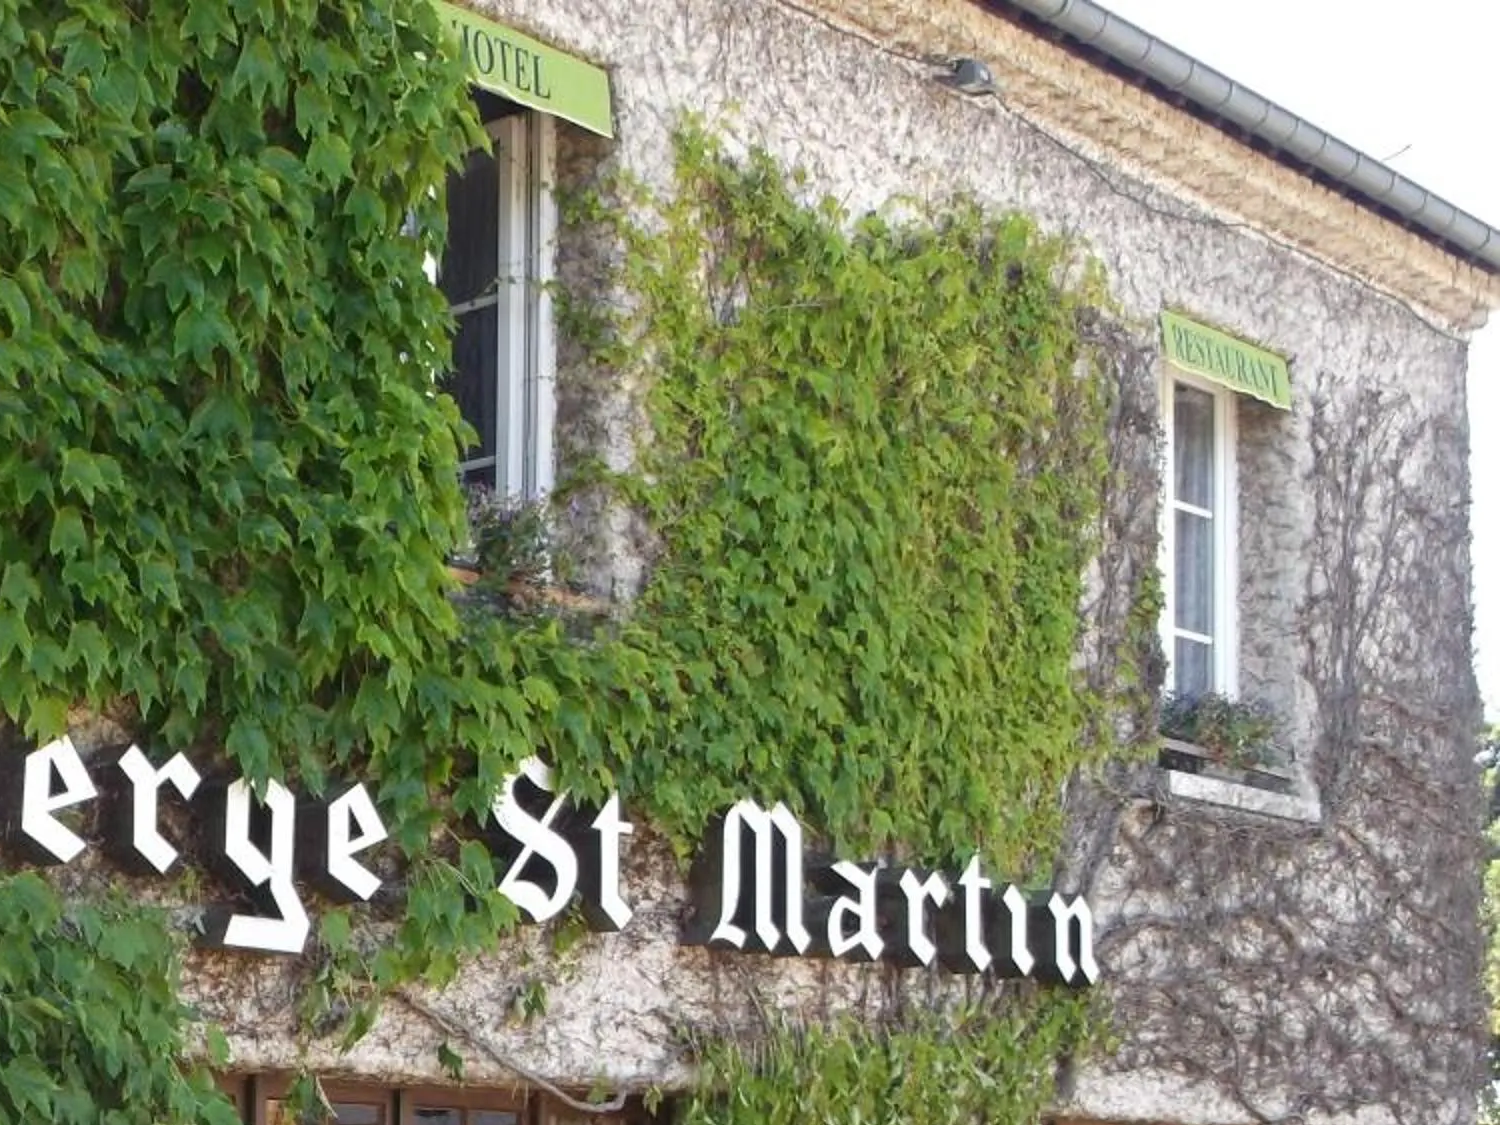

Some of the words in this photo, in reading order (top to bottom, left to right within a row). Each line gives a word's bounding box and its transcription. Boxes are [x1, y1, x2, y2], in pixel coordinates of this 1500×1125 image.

[1171, 322, 1279, 398] RESTAURANT
[496, 754, 633, 932] St
[709, 798, 1099, 985] Martin
